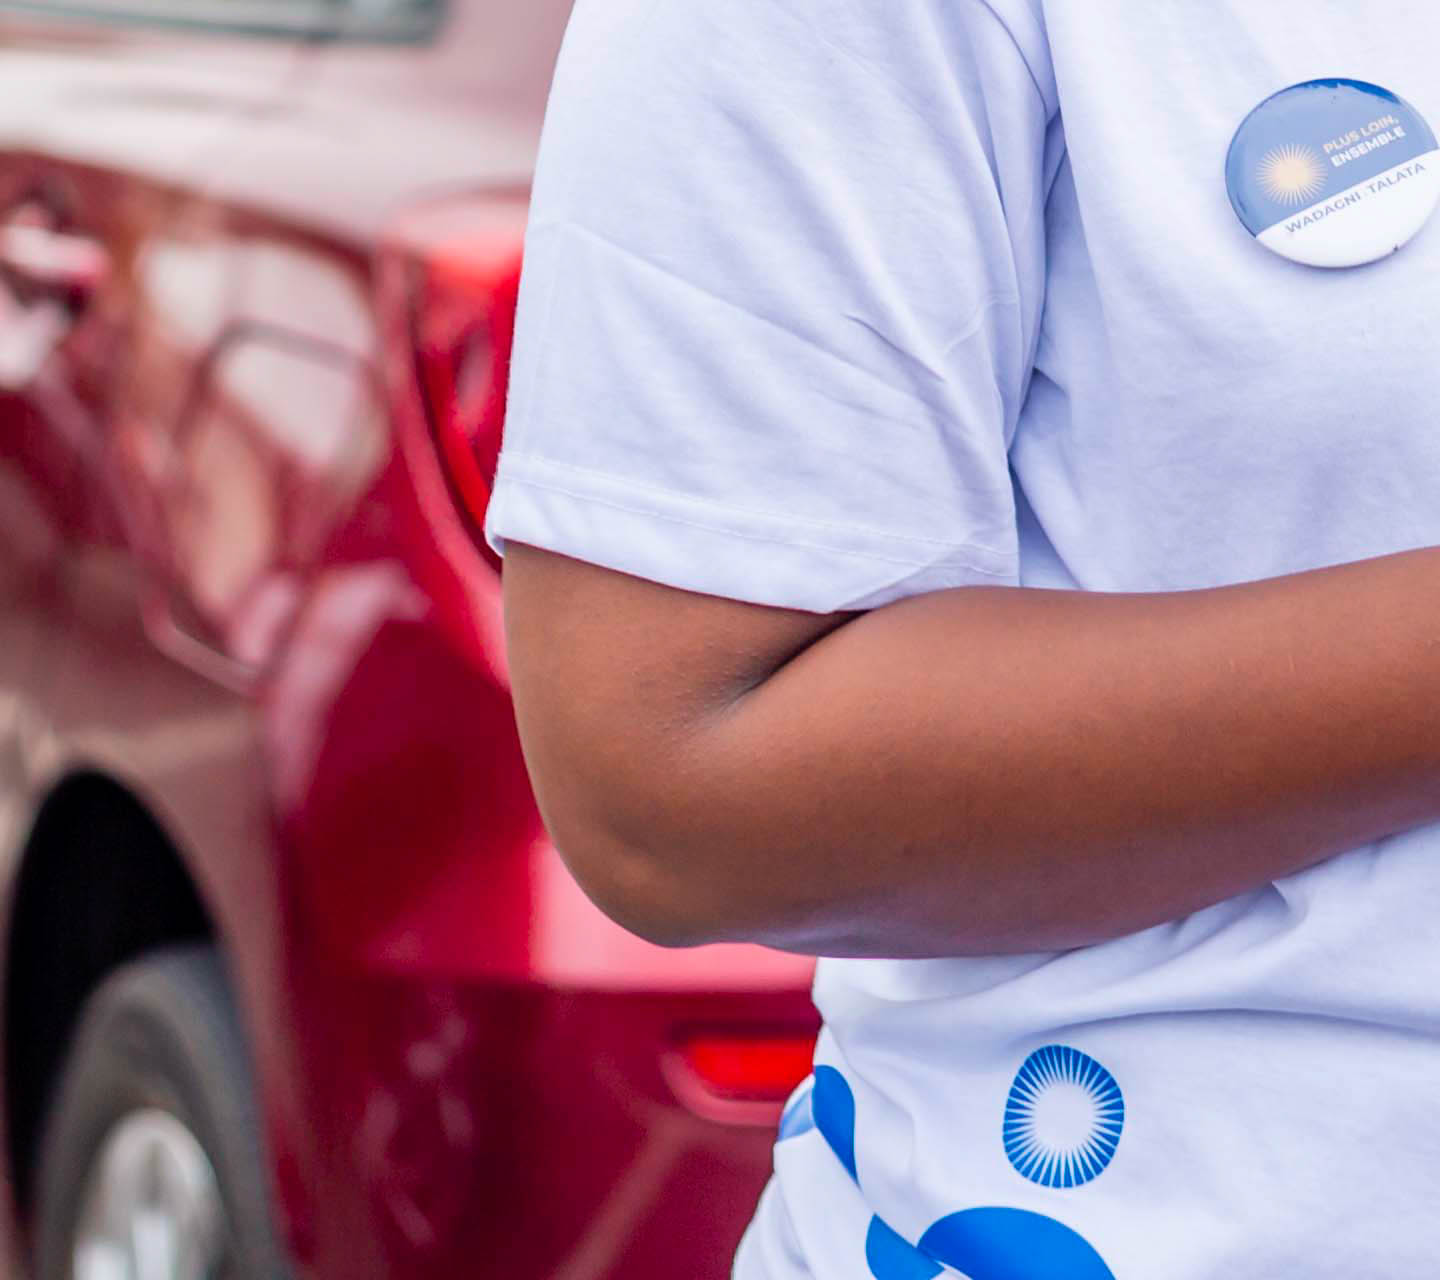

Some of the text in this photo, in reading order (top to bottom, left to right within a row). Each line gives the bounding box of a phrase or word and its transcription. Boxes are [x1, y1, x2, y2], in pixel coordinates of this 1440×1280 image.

[1323, 130, 1361, 154] PLUS
[1330, 125, 1406, 168] ENSEMBLE
[1284, 162, 1427, 233] WADAGNI TALATA
